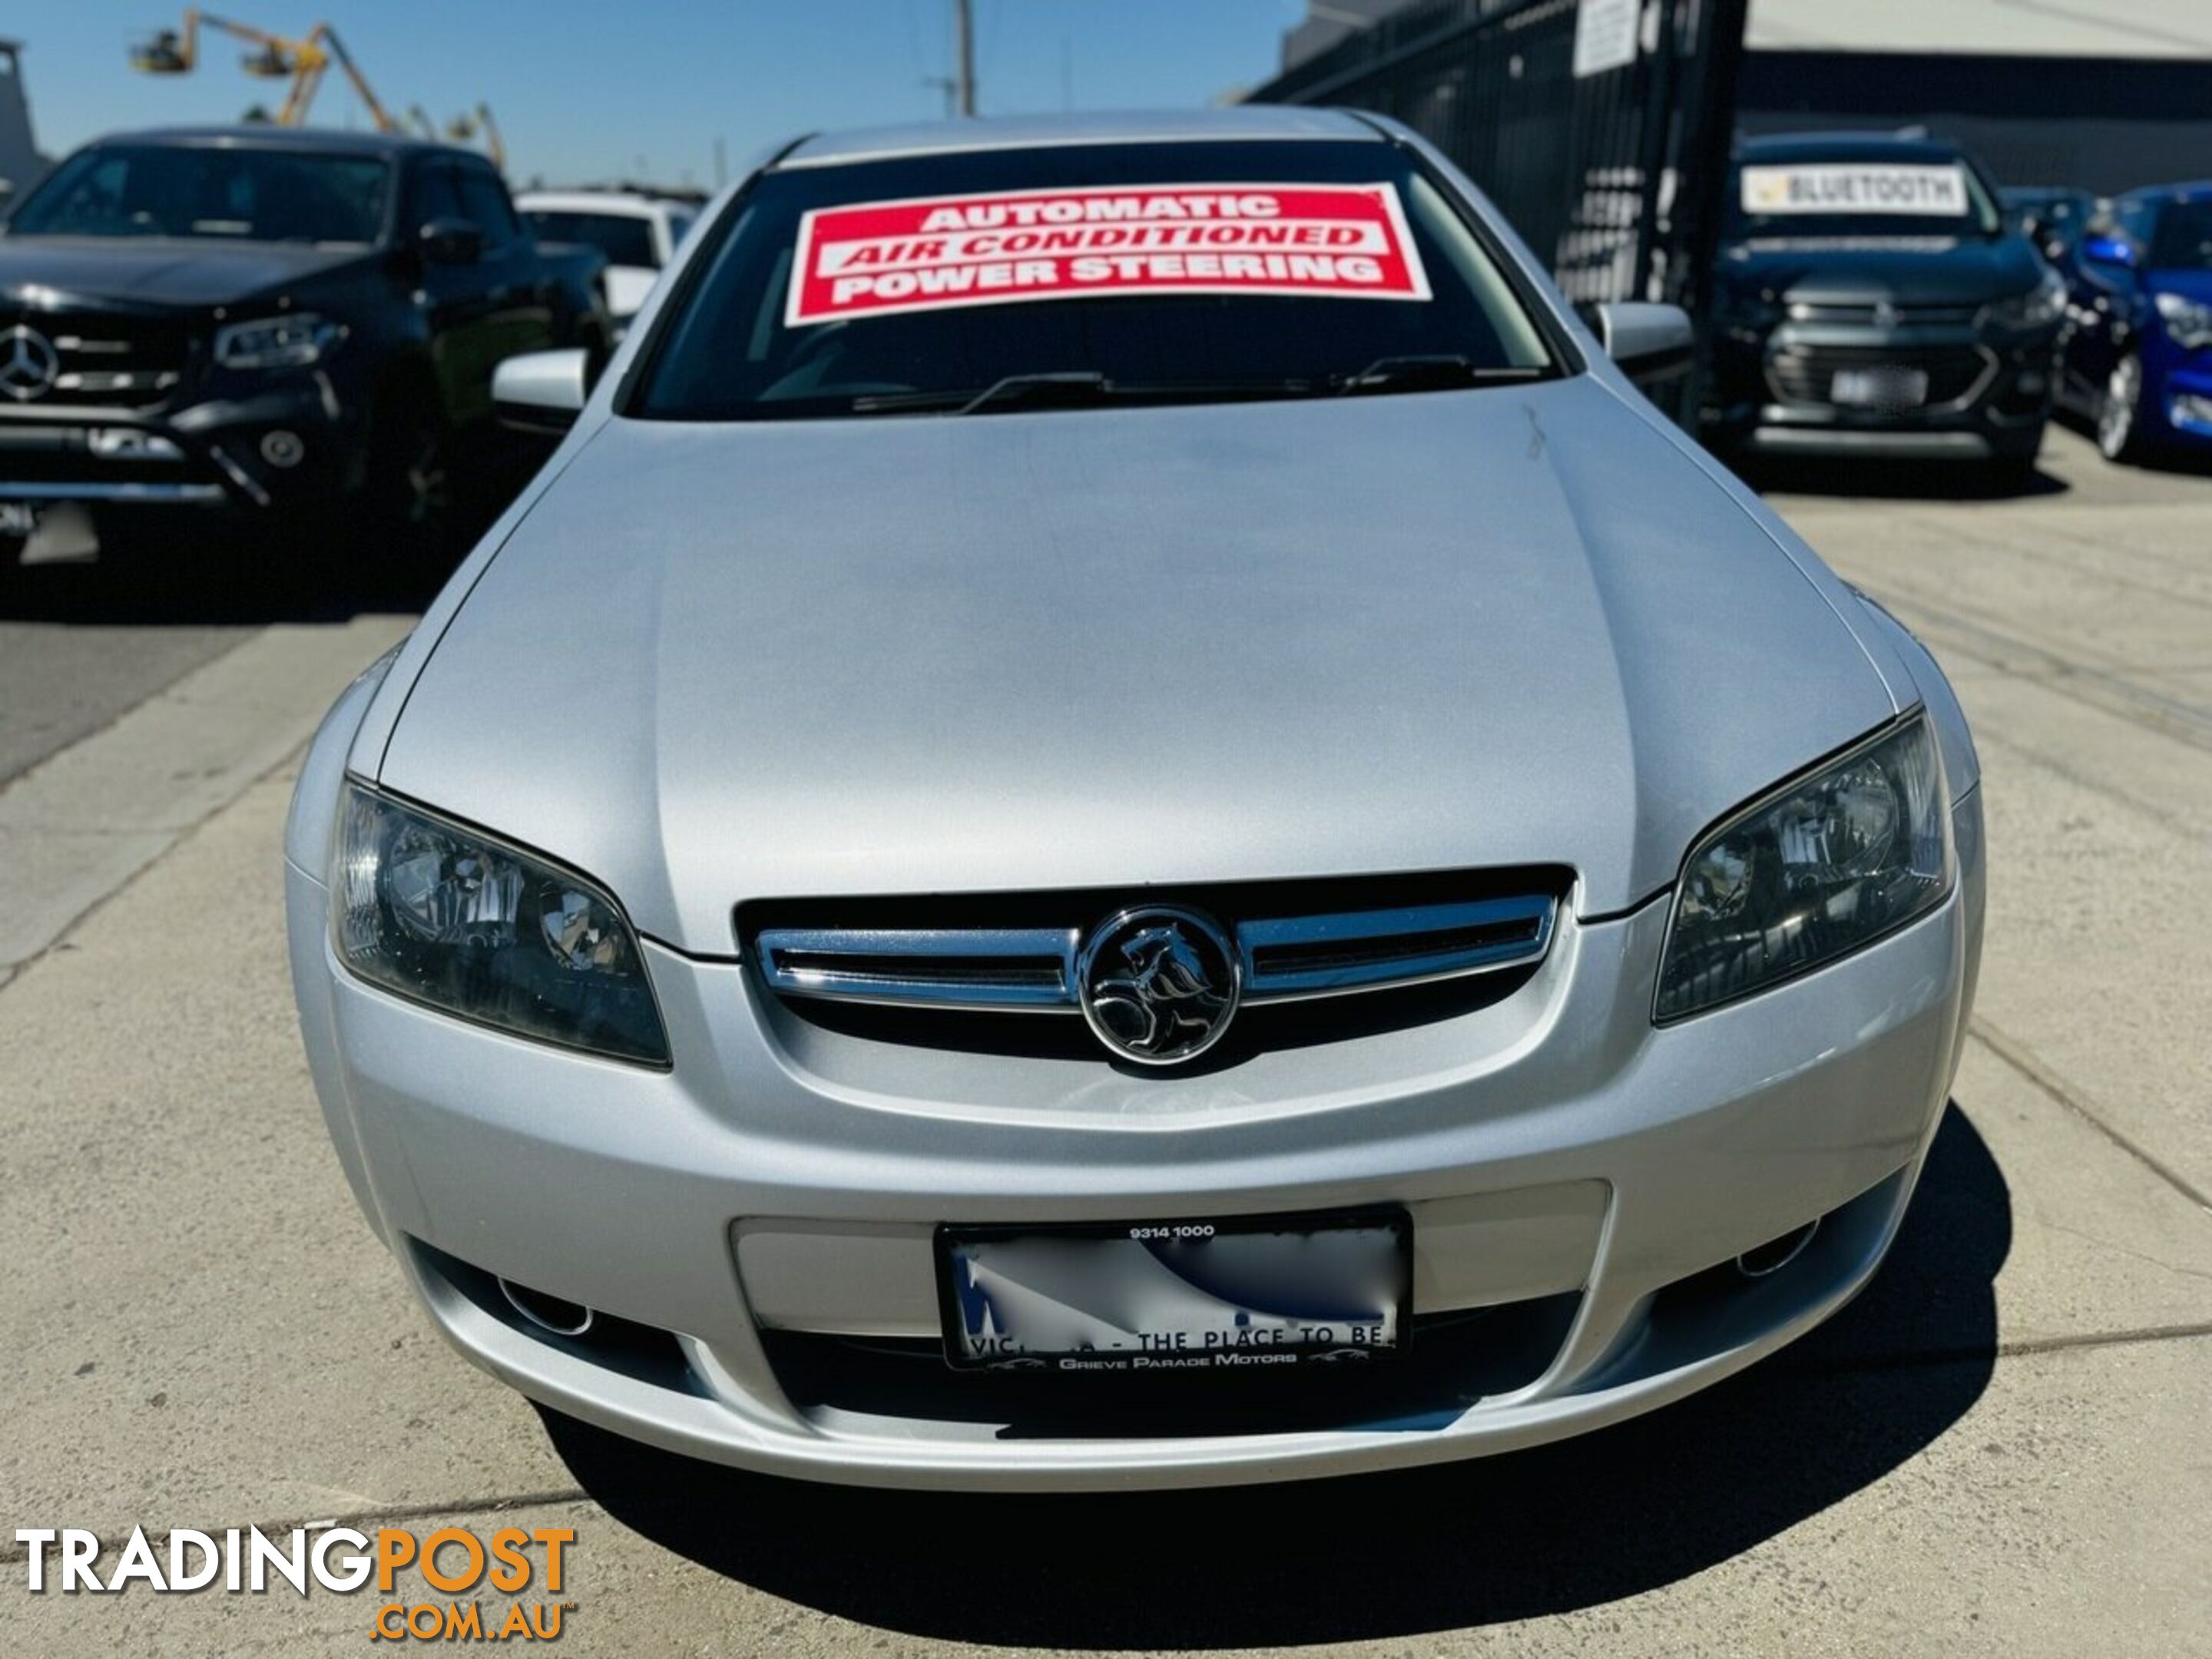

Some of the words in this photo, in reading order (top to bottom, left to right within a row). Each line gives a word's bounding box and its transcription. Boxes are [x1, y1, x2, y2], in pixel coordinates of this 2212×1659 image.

[1790, 175, 1955, 202] BLUETOOTH
[922, 195, 1280, 233] AUTOMATIC
[841, 239, 949, 267] AIR
[962, 226, 1364, 254] CONDITIONED
[832, 260, 1058, 304] POWER
[1070, 255, 1384, 283] STEERING
[1130, 1227, 1170, 1238] 9314
[1173, 1225, 1214, 1237] 1000
[1138, 1332, 1187, 1350] THE
[1204, 1328, 1283, 1346] PLACE
[1300, 1326, 1333, 1343] TO
[1352, 1326, 1382, 1343] BE
[1059, 1358, 1127, 1370] GRIEVE
[1133, 1356, 1210, 1369] PARADE
[1216, 1353, 1297, 1366] MOTORS
